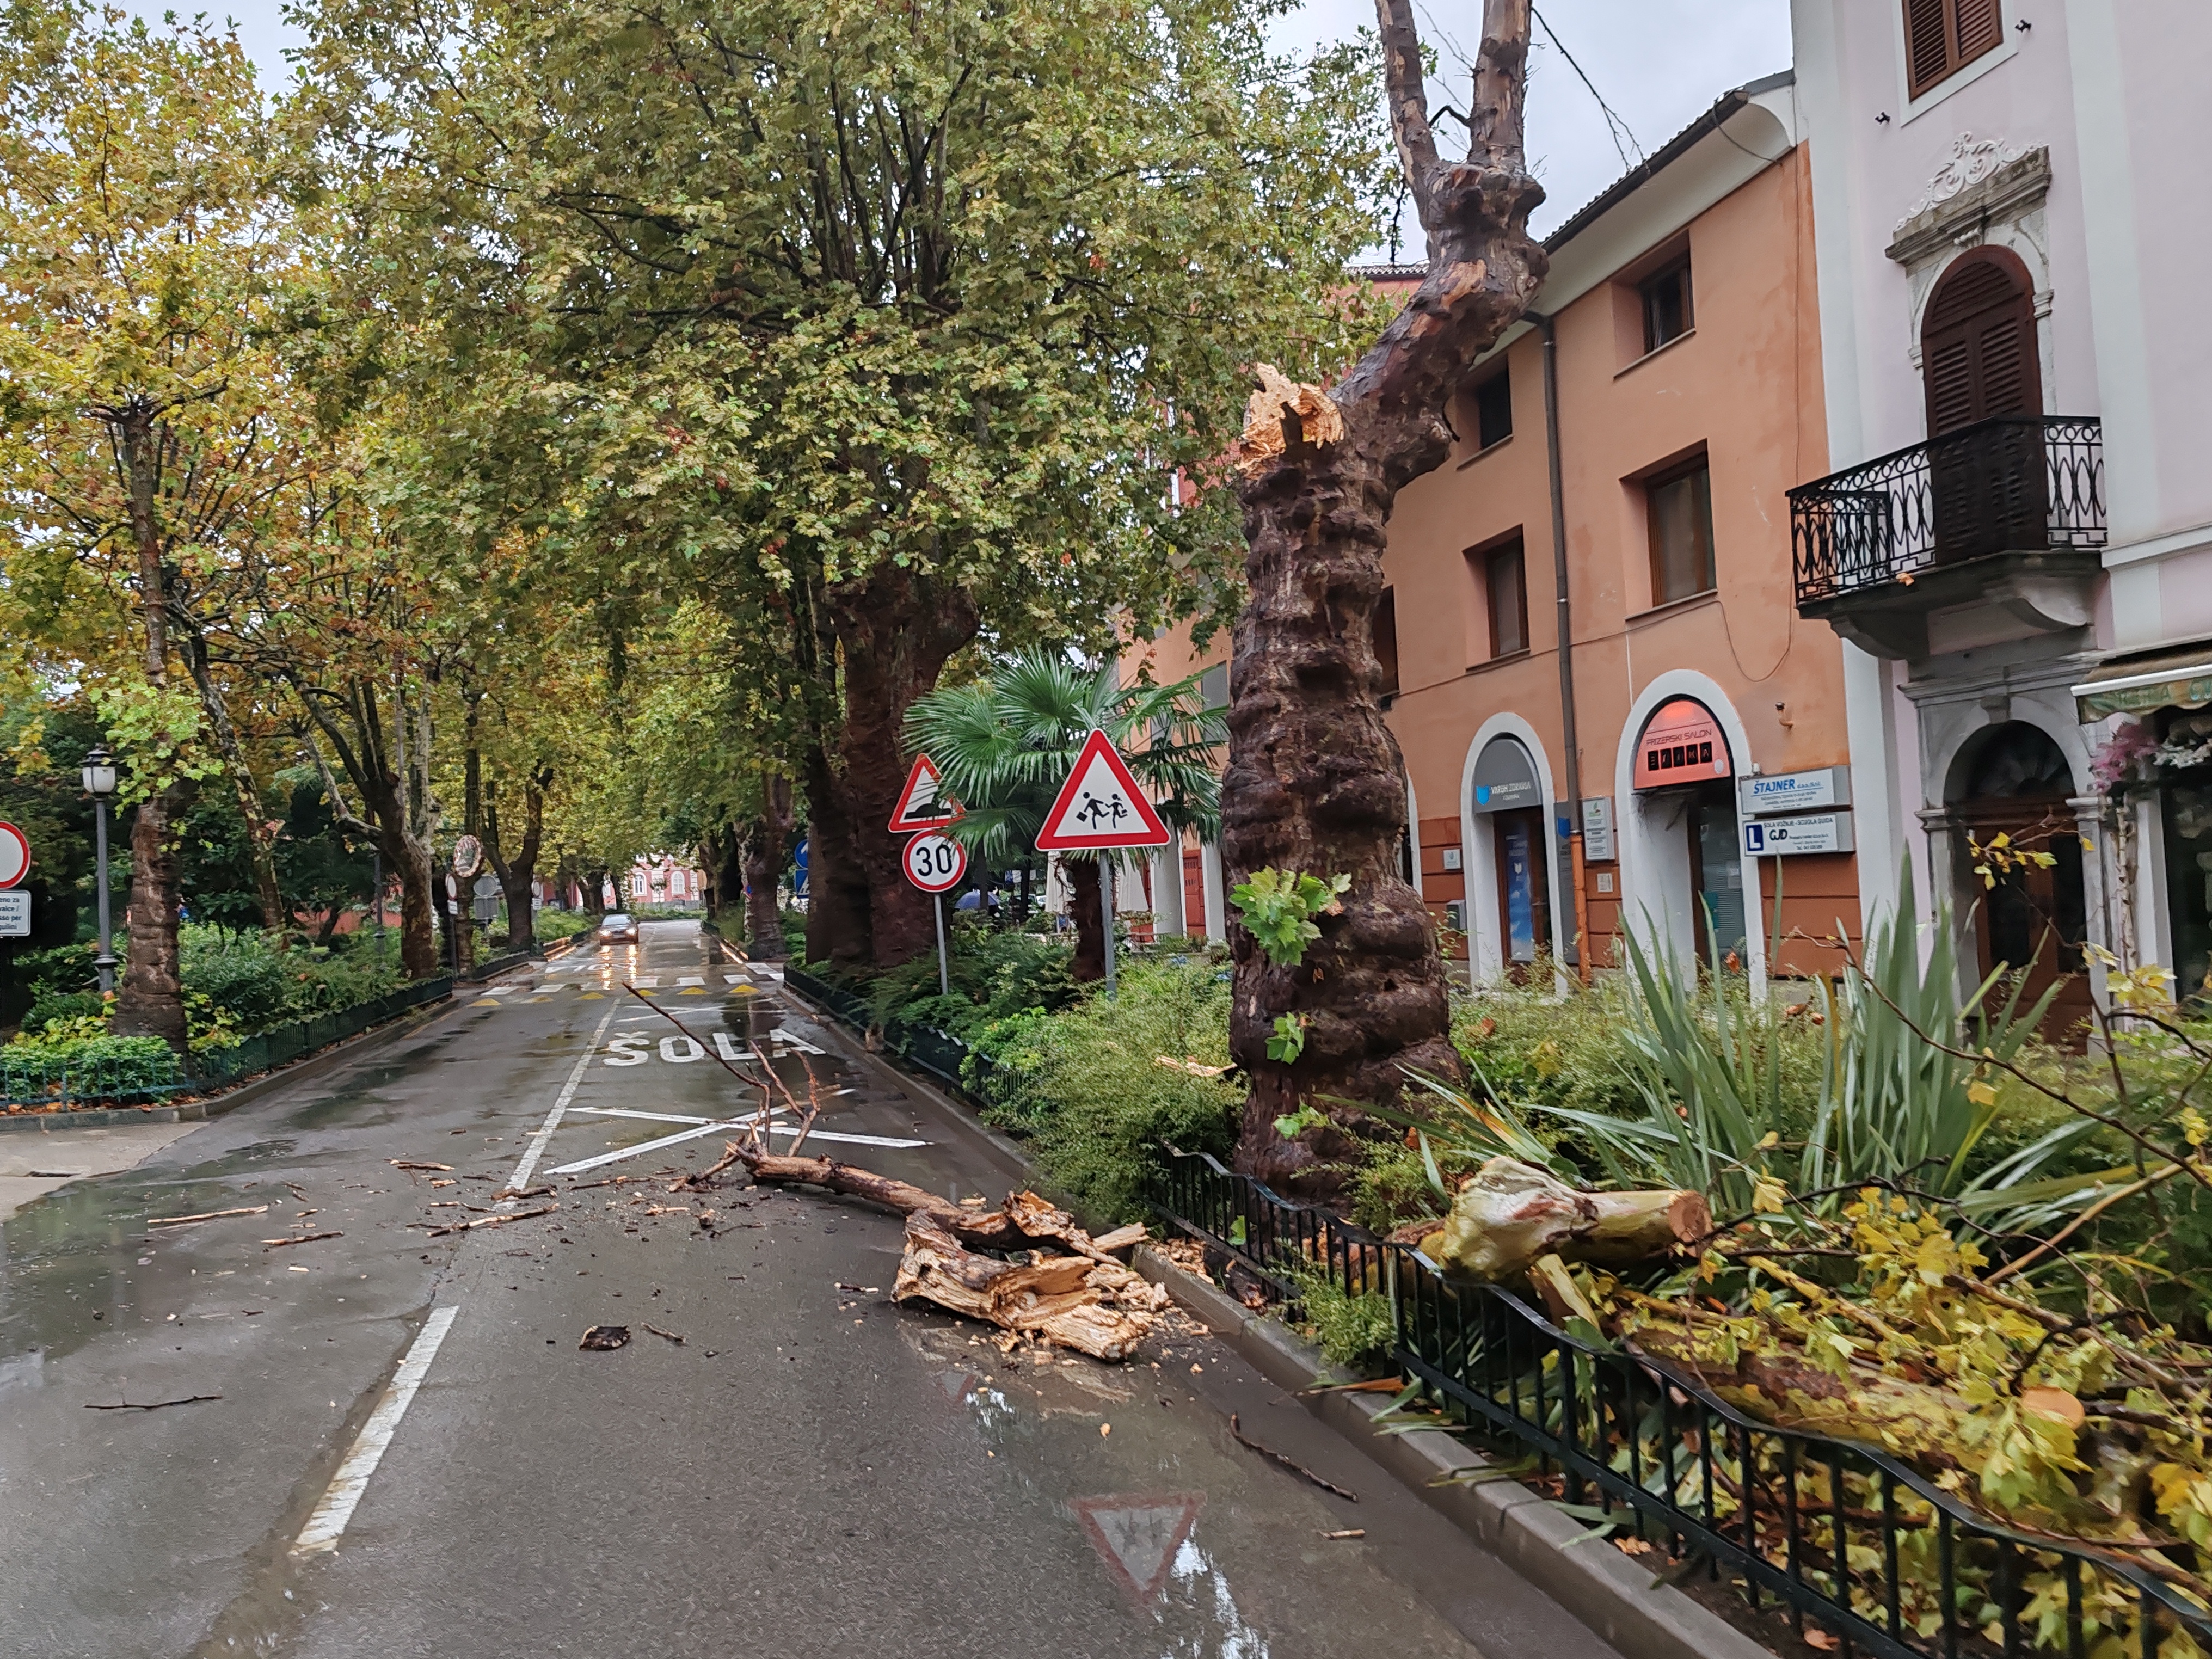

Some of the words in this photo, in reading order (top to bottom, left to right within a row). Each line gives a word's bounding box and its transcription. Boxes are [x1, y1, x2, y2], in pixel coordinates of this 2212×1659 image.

[1684, 729, 1712, 740] SALON
[1753, 779, 1796, 794] ŠTAJNER
[916, 844, 952, 877] 30
[602, 1029, 827, 1066] ŠOLA
